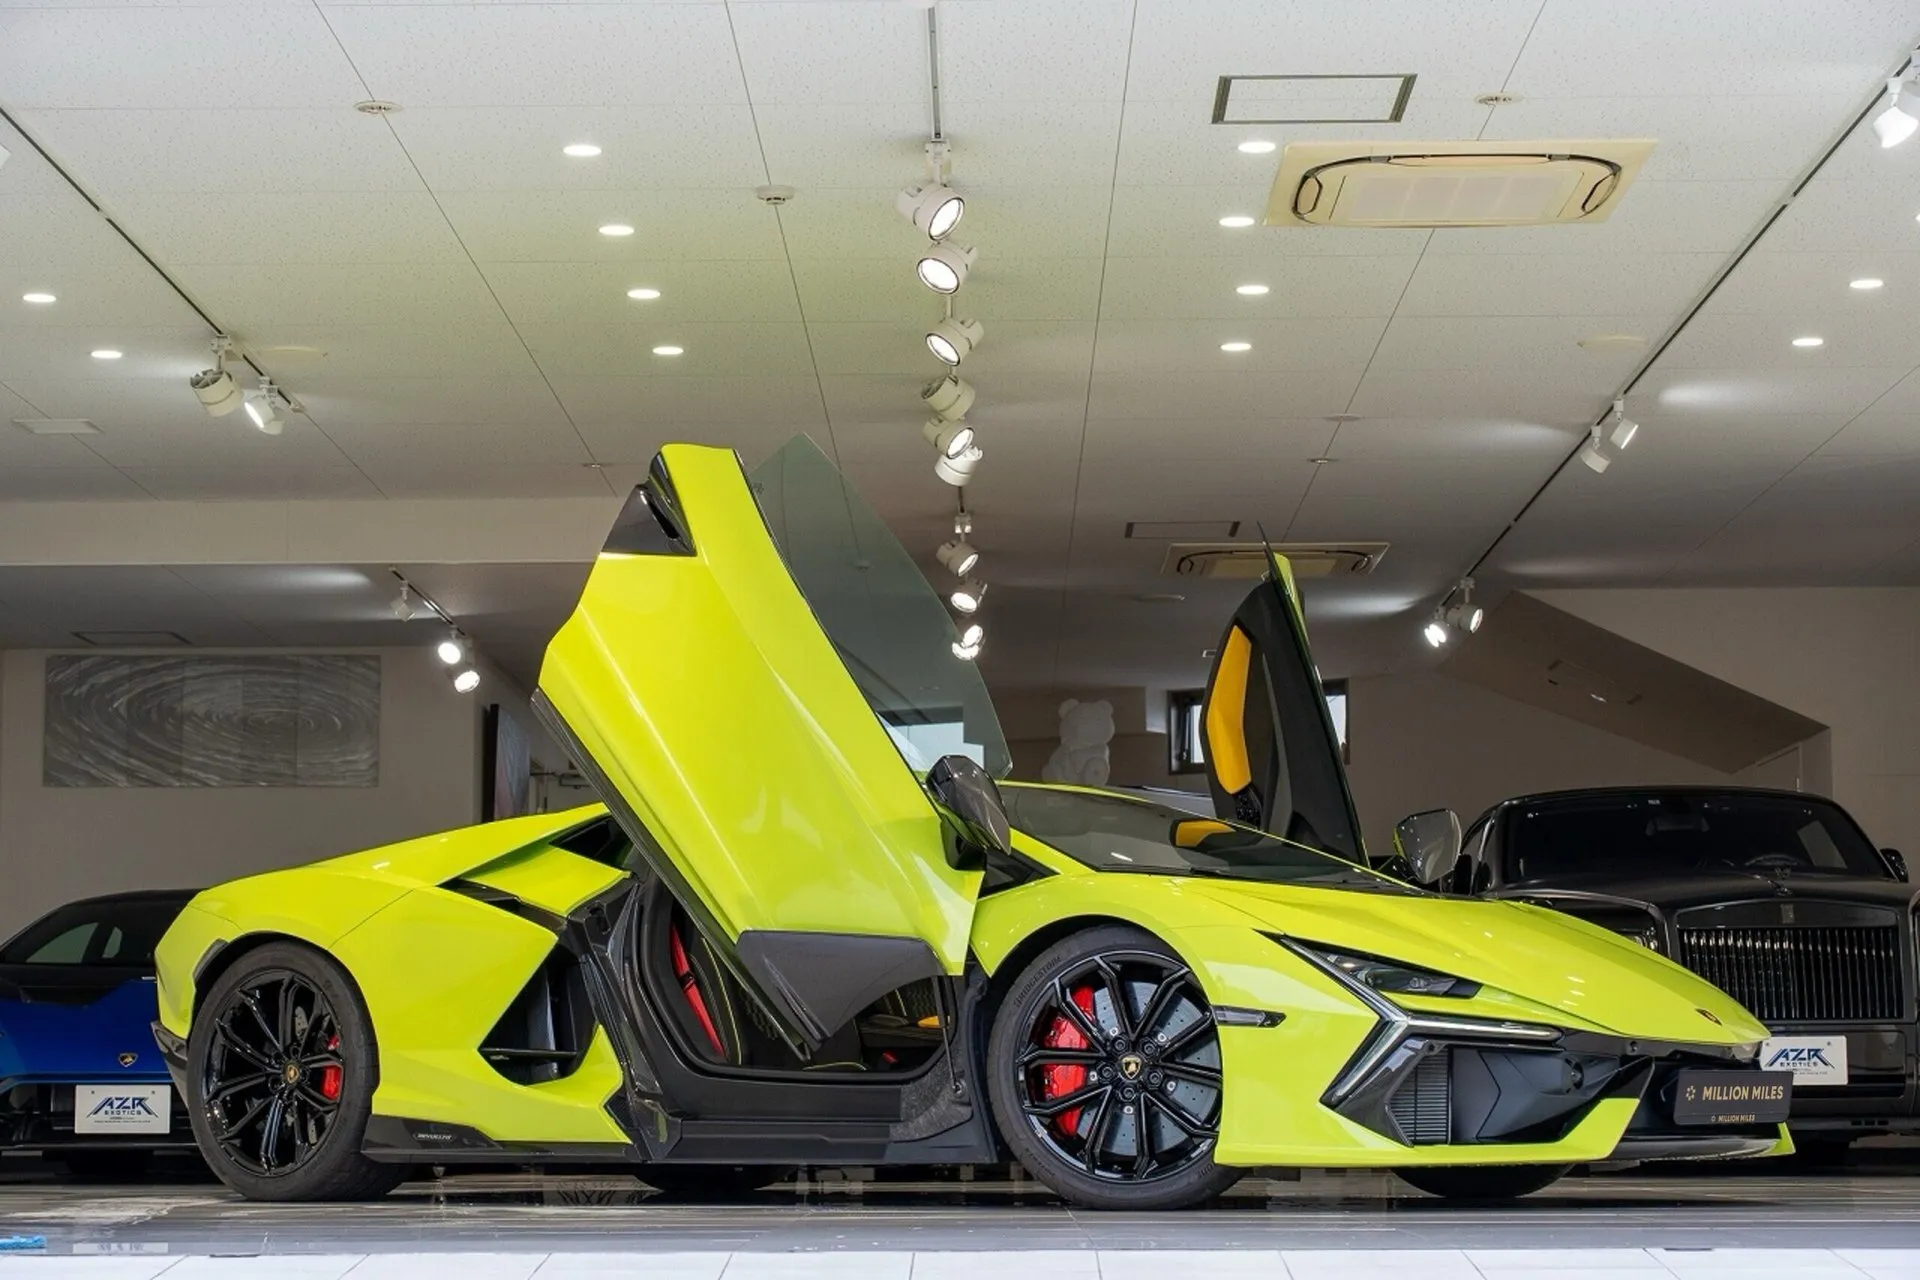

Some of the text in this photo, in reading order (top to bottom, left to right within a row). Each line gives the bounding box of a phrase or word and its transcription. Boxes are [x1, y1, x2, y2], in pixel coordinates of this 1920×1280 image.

[1764, 1048, 1835, 1069] AZR
[1702, 1085, 1784, 1101] MILLION MILES
[86, 1096, 159, 1118] AZR
[1740, 1114, 1756, 1122] MILES
